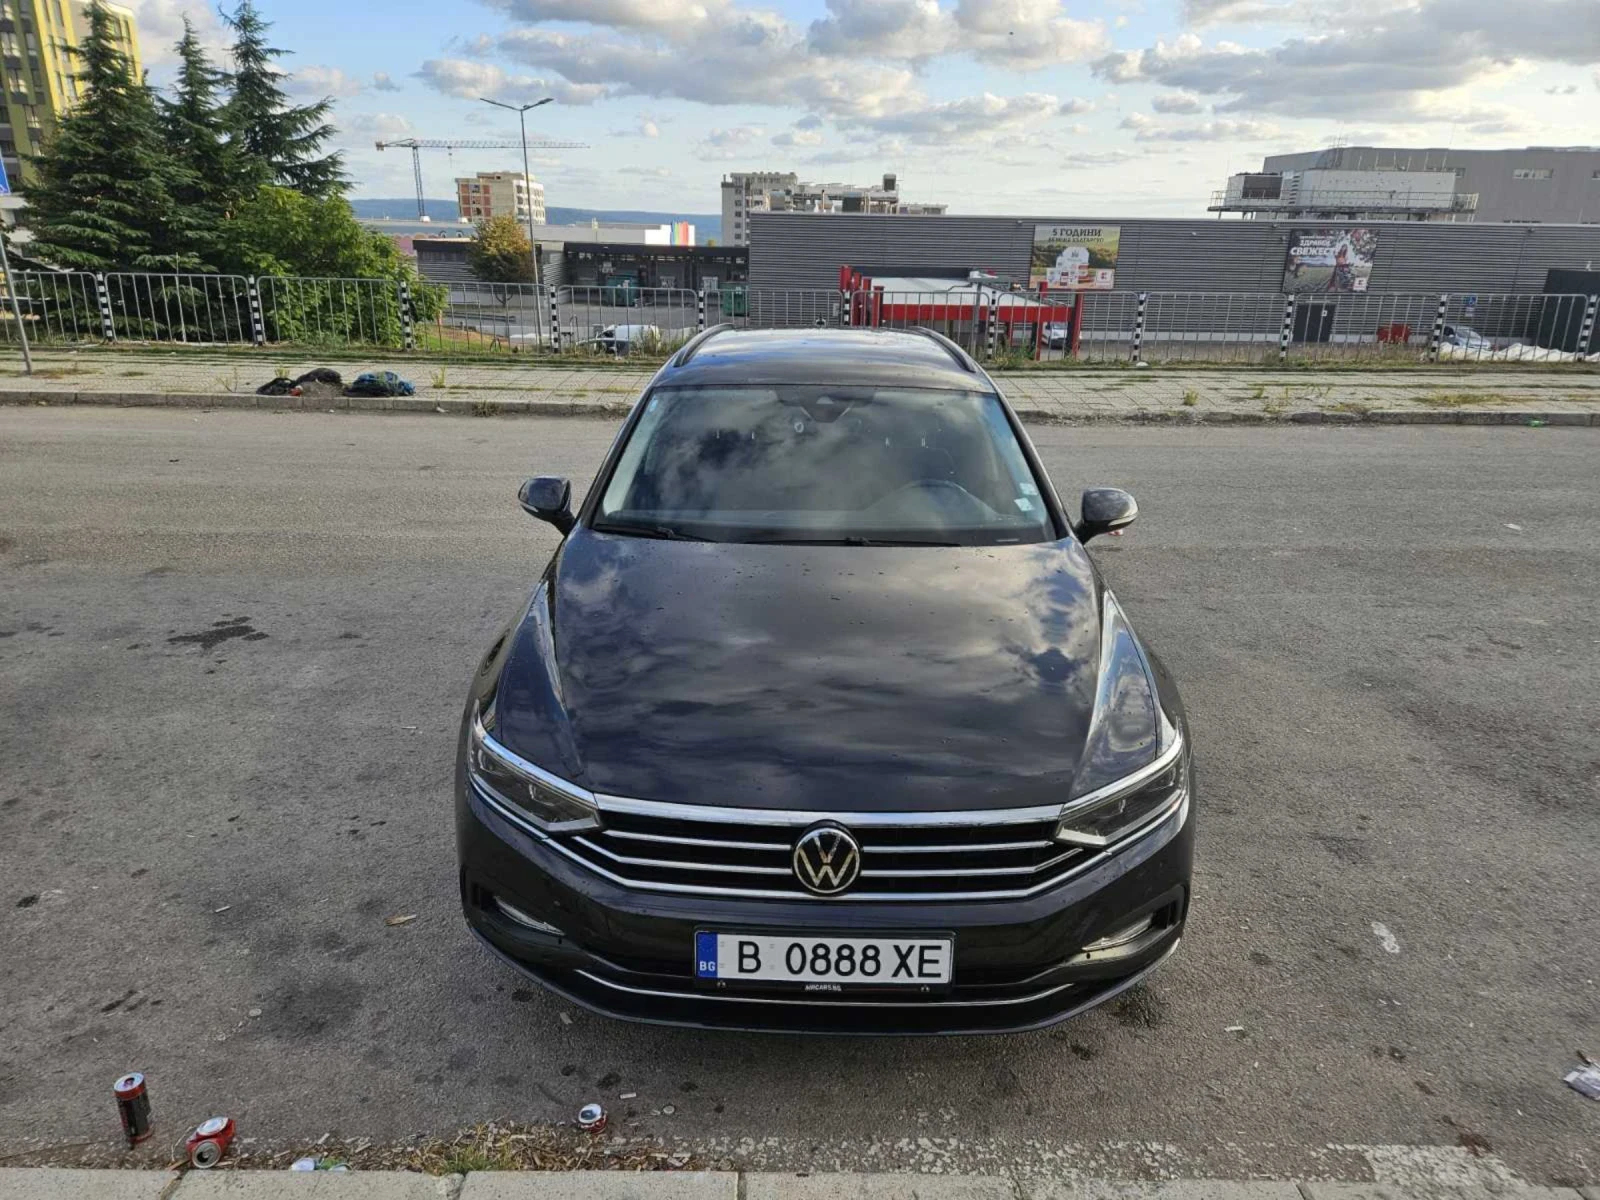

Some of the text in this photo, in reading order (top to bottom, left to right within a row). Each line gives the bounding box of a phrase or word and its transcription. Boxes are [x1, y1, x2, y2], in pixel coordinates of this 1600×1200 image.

[1053, 228, 1102, 237] 5 ГОДИНИ
[699, 940, 942, 979] BG B 0888 XE
